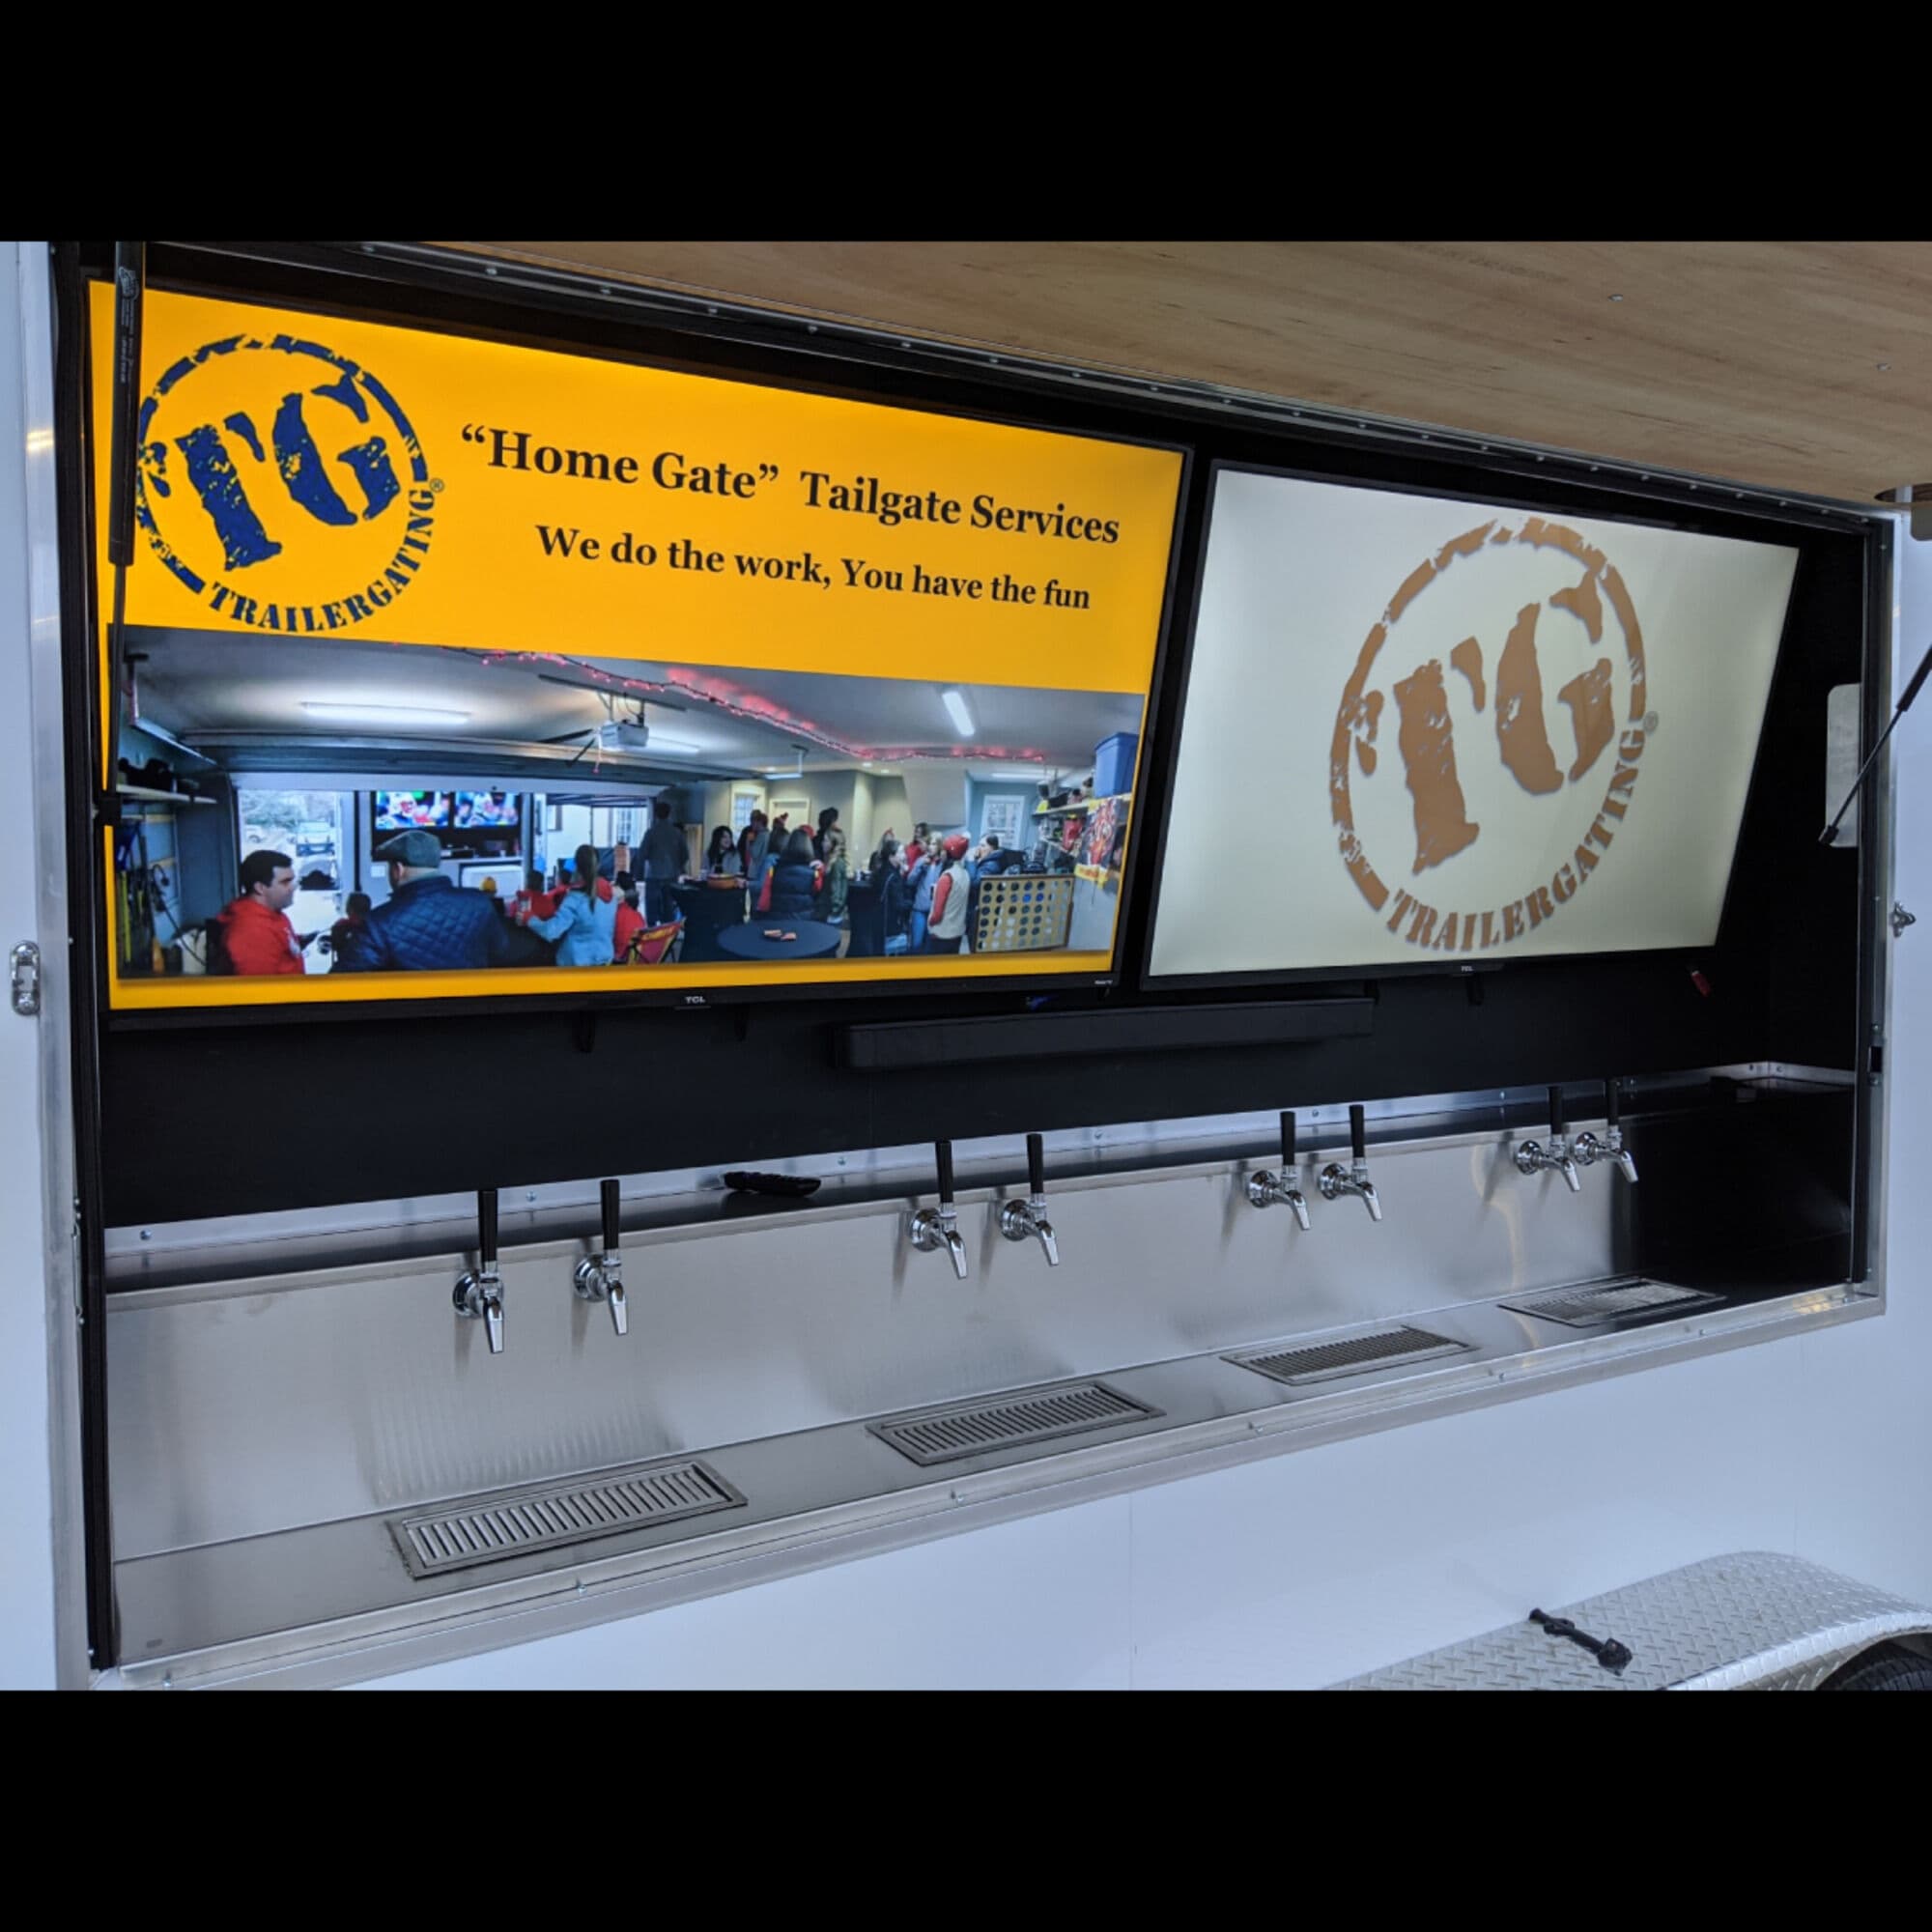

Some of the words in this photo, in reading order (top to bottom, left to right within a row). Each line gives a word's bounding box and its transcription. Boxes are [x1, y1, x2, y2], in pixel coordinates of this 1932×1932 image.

[140, 373, 401, 571] TG
[800, 470, 961, 526] Tailgate
[970, 496, 1121, 544] Services
[537, 526, 600, 559] We
[611, 532, 657, 565] do
[668, 540, 724, 573] the
[735, 553, 831, 587] work,
[841, 558, 902, 591] You
[912, 565, 983, 599] have
[990, 574, 1037, 605] the
[1043, 579, 1091, 610] fun
[1353, 568, 1615, 874] TG
[685, 995, 707, 1005] TCL
